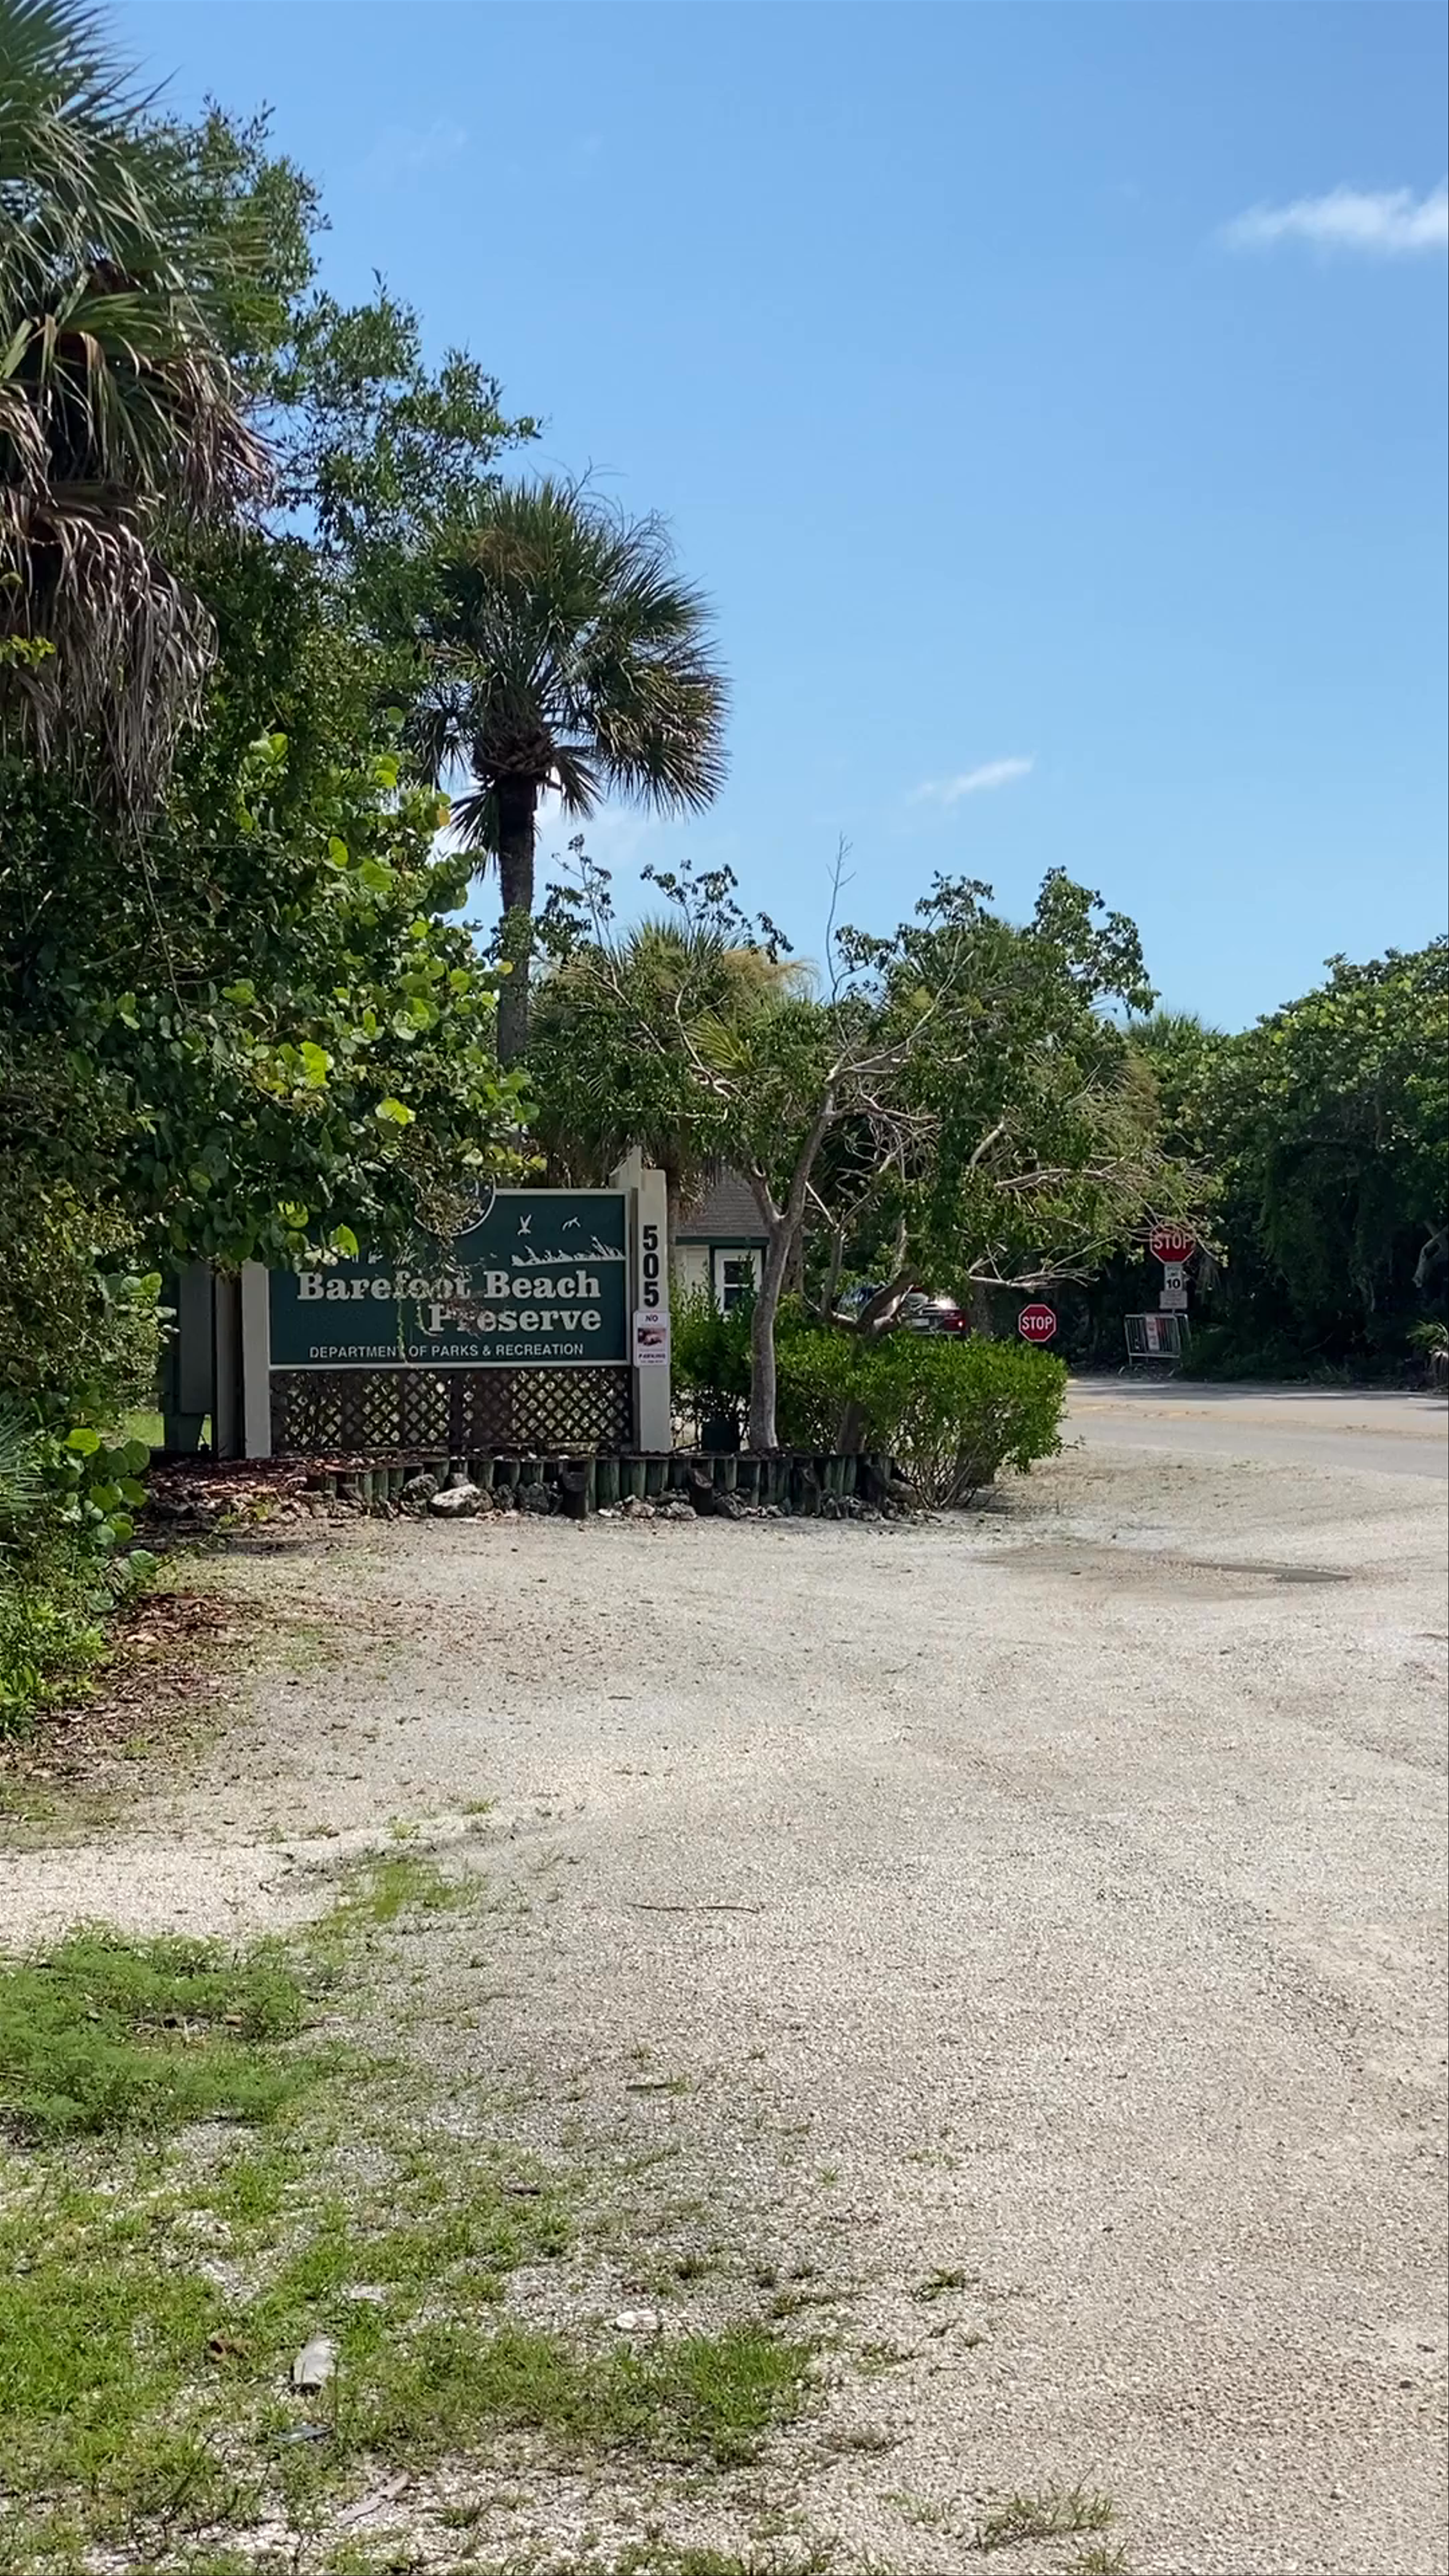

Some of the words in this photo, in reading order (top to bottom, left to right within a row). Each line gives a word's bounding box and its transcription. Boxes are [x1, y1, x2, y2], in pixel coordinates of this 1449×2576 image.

[1154, 1233, 1193, 1249] STOP
[643, 1225, 660, 1308] 505
[297, 1270, 471, 1300] Barefoot
[483, 1270, 601, 1298] Beach
[1166, 1278, 1181, 1289] 10
[1021, 1315, 1053, 1330] STOP
[309, 1346, 404, 1358] DEPARTMEN
[408, 1345, 427, 1358] OF
[431, 1344, 478, 1357] PARKS
[482, 1344, 491, 1356] &
[495, 1343, 583, 1356] RECREATION
